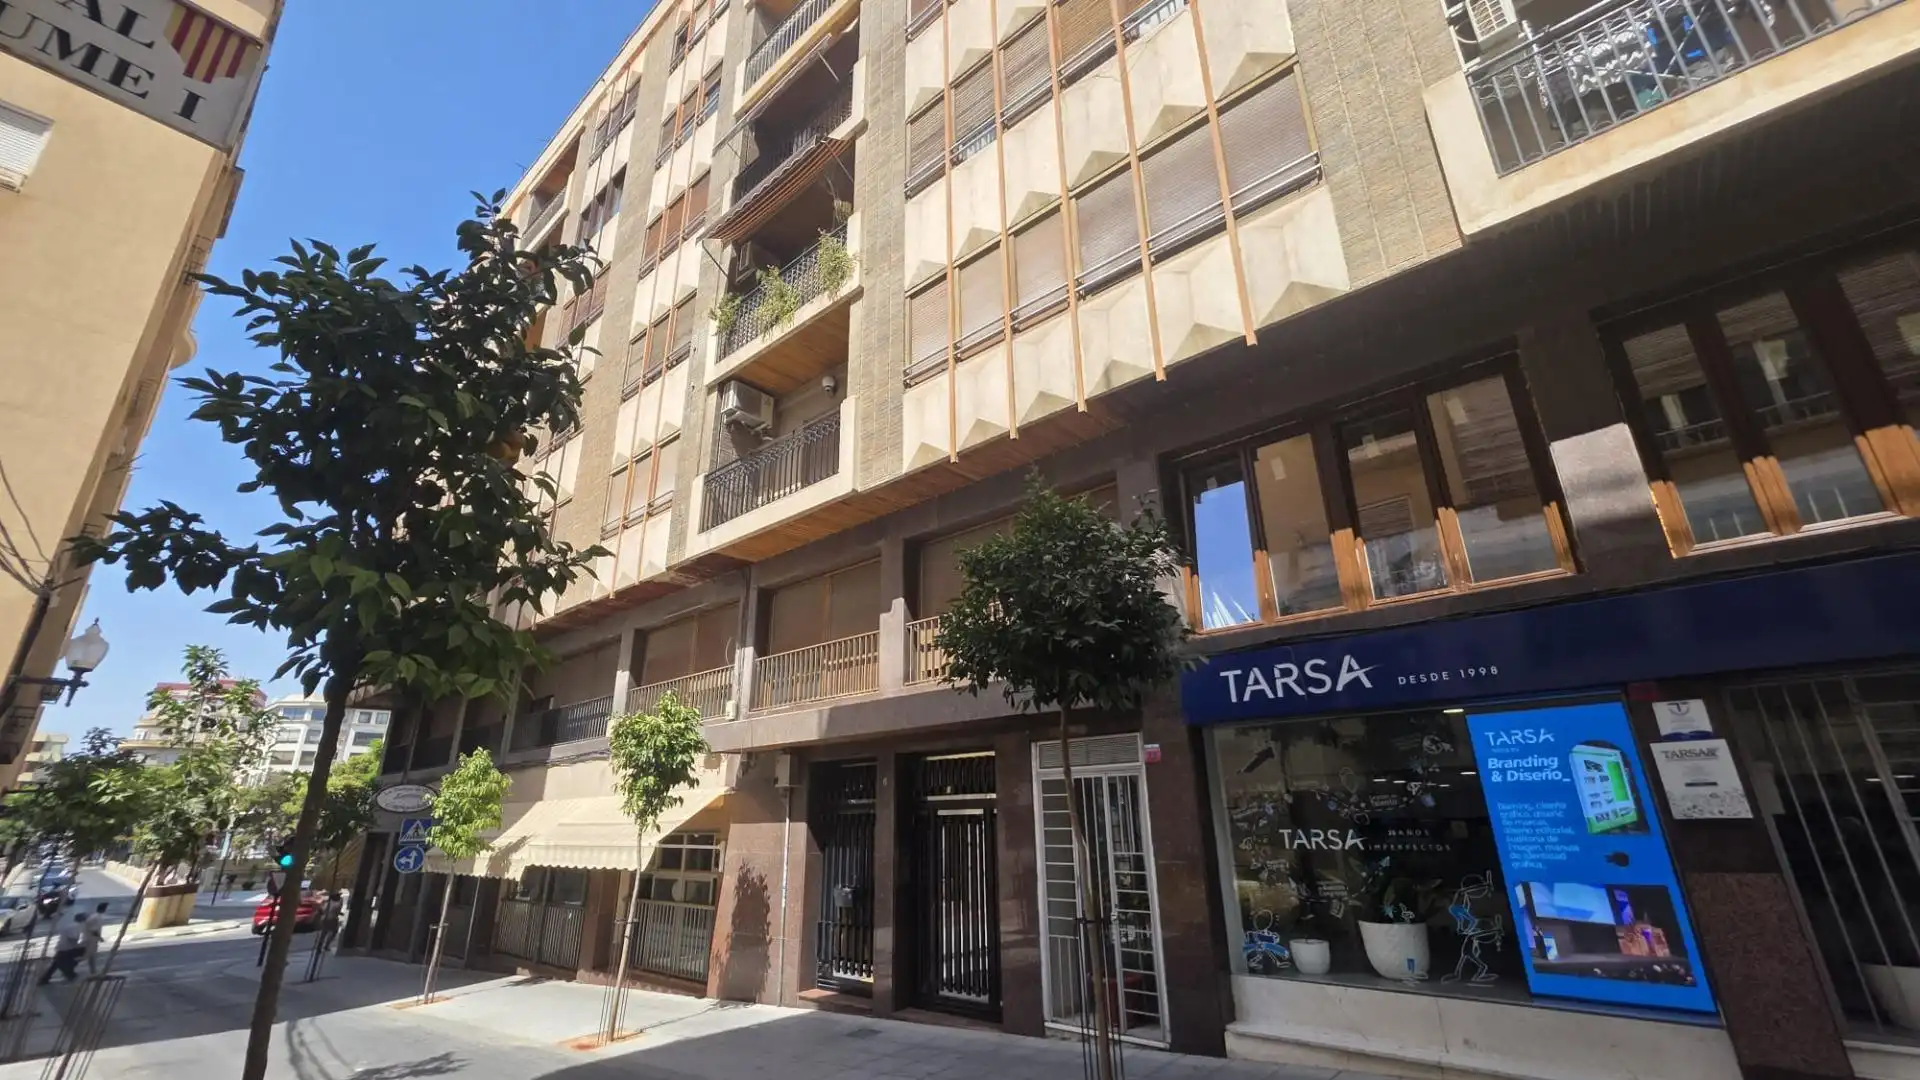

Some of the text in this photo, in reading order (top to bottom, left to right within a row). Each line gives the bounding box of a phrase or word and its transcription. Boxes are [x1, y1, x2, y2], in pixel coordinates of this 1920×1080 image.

[173, 88, 207, 124] I
[1219, 654, 1499, 703] TARSA DESDE 1998
[1484, 727, 1556, 747] TARSA
[1487, 754, 1559, 769] Branding
[1491, 770, 1503, 782] &
[1278, 829, 1368, 851] TARSA
